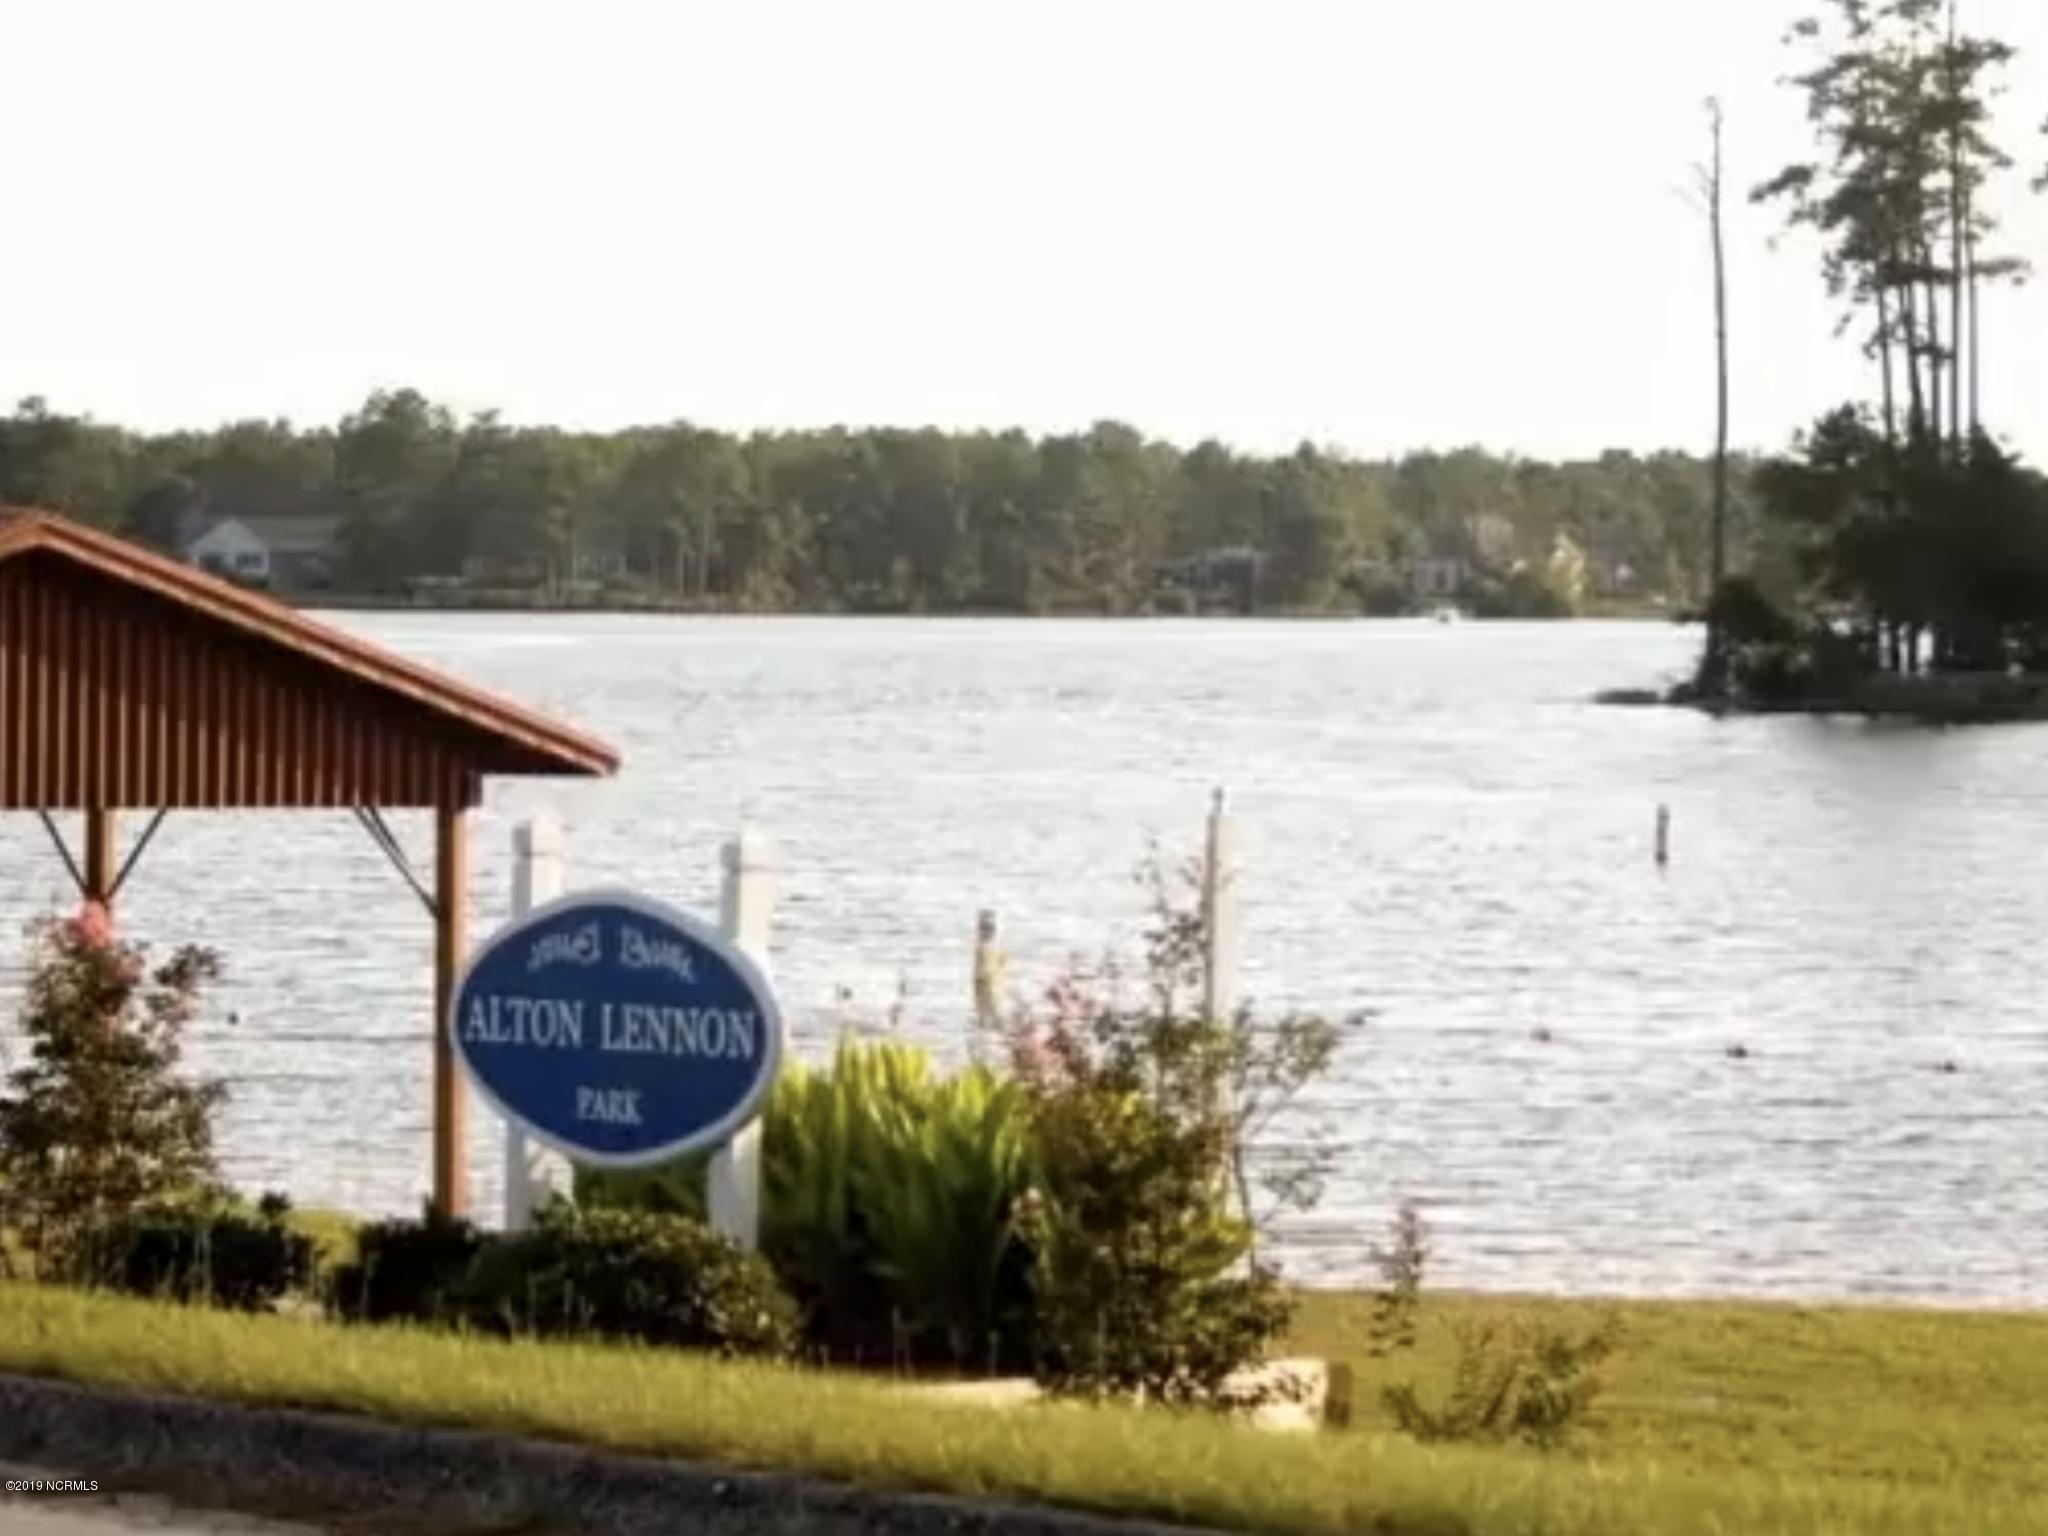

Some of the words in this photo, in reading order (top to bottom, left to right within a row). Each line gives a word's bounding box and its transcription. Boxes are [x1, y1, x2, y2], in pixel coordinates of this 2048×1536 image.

[464, 995, 584, 1048] ALTON
[601, 1003, 754, 1059] LENNON
[576, 1085, 644, 1125] PARK
